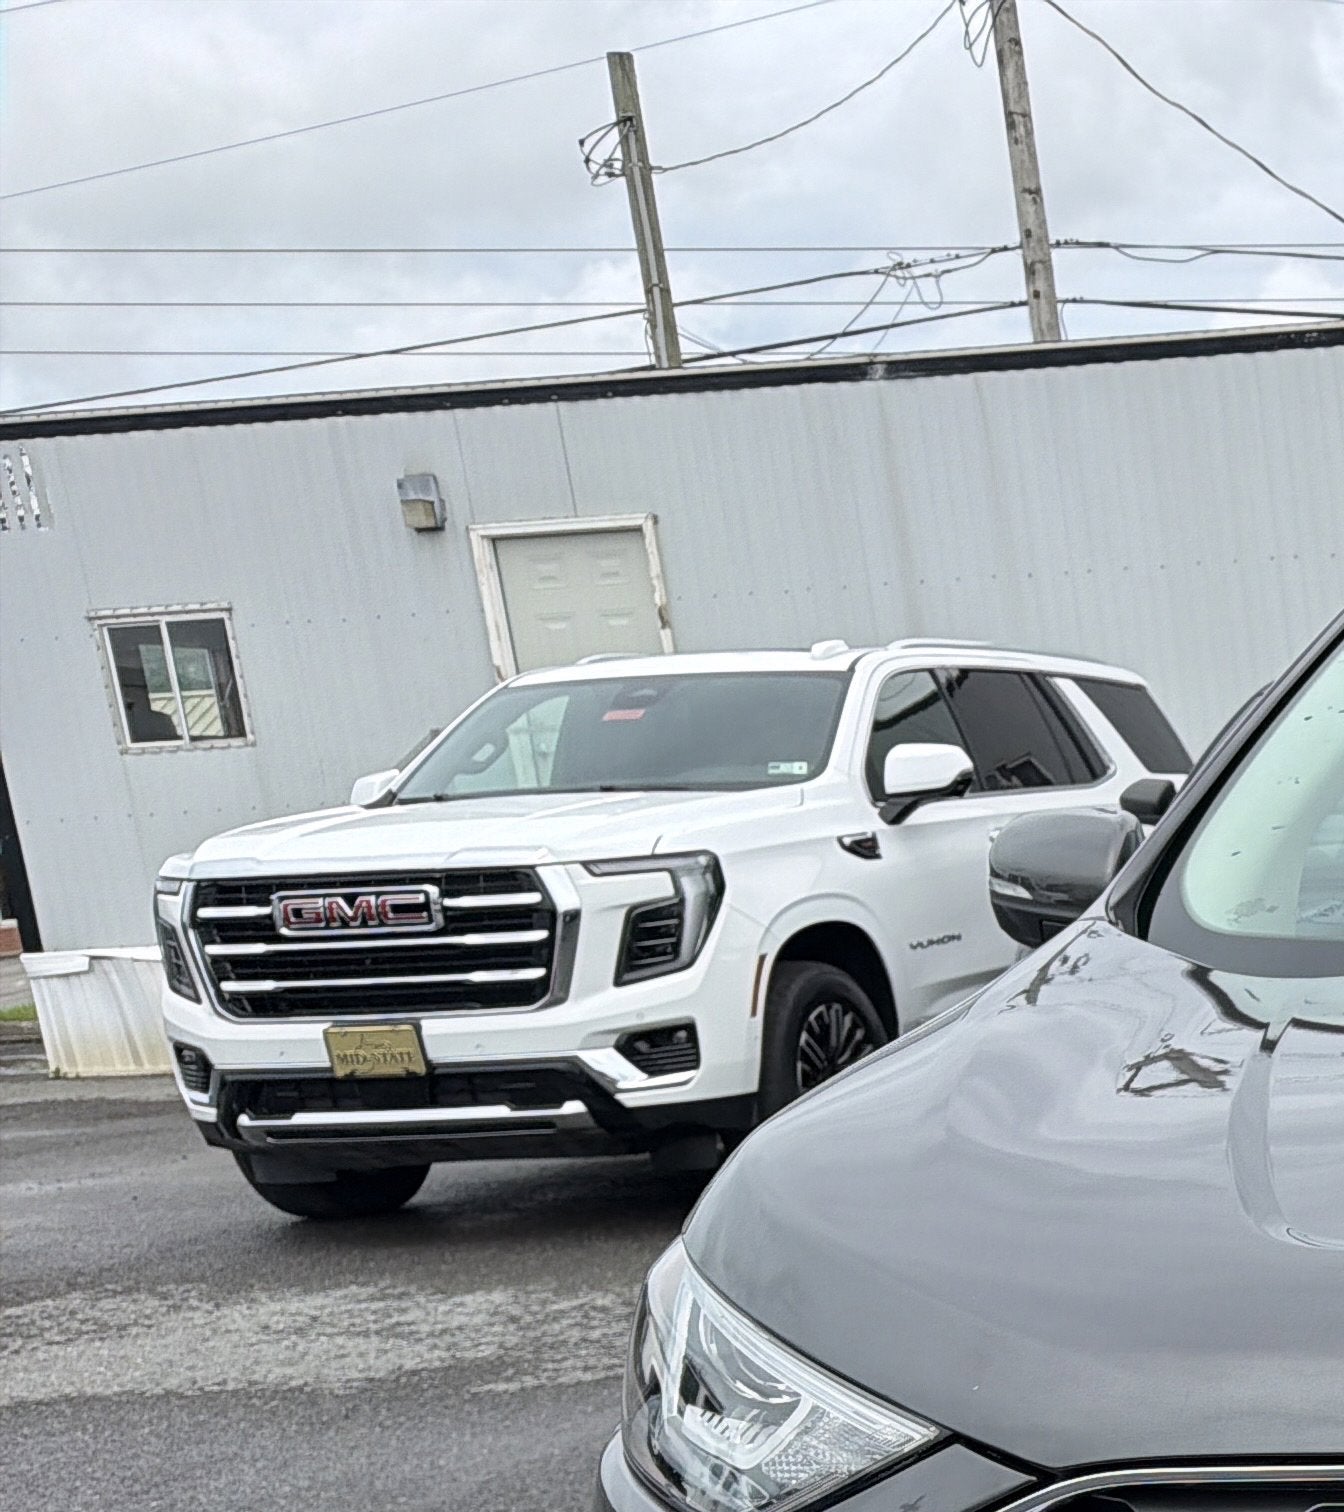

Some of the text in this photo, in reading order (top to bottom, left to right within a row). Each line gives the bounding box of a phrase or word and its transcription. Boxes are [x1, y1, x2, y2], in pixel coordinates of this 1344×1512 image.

[279, 892, 429, 929] GMC
[909, 932, 962, 950] YUKON
[335, 1049, 416, 1067] MID-STATE
